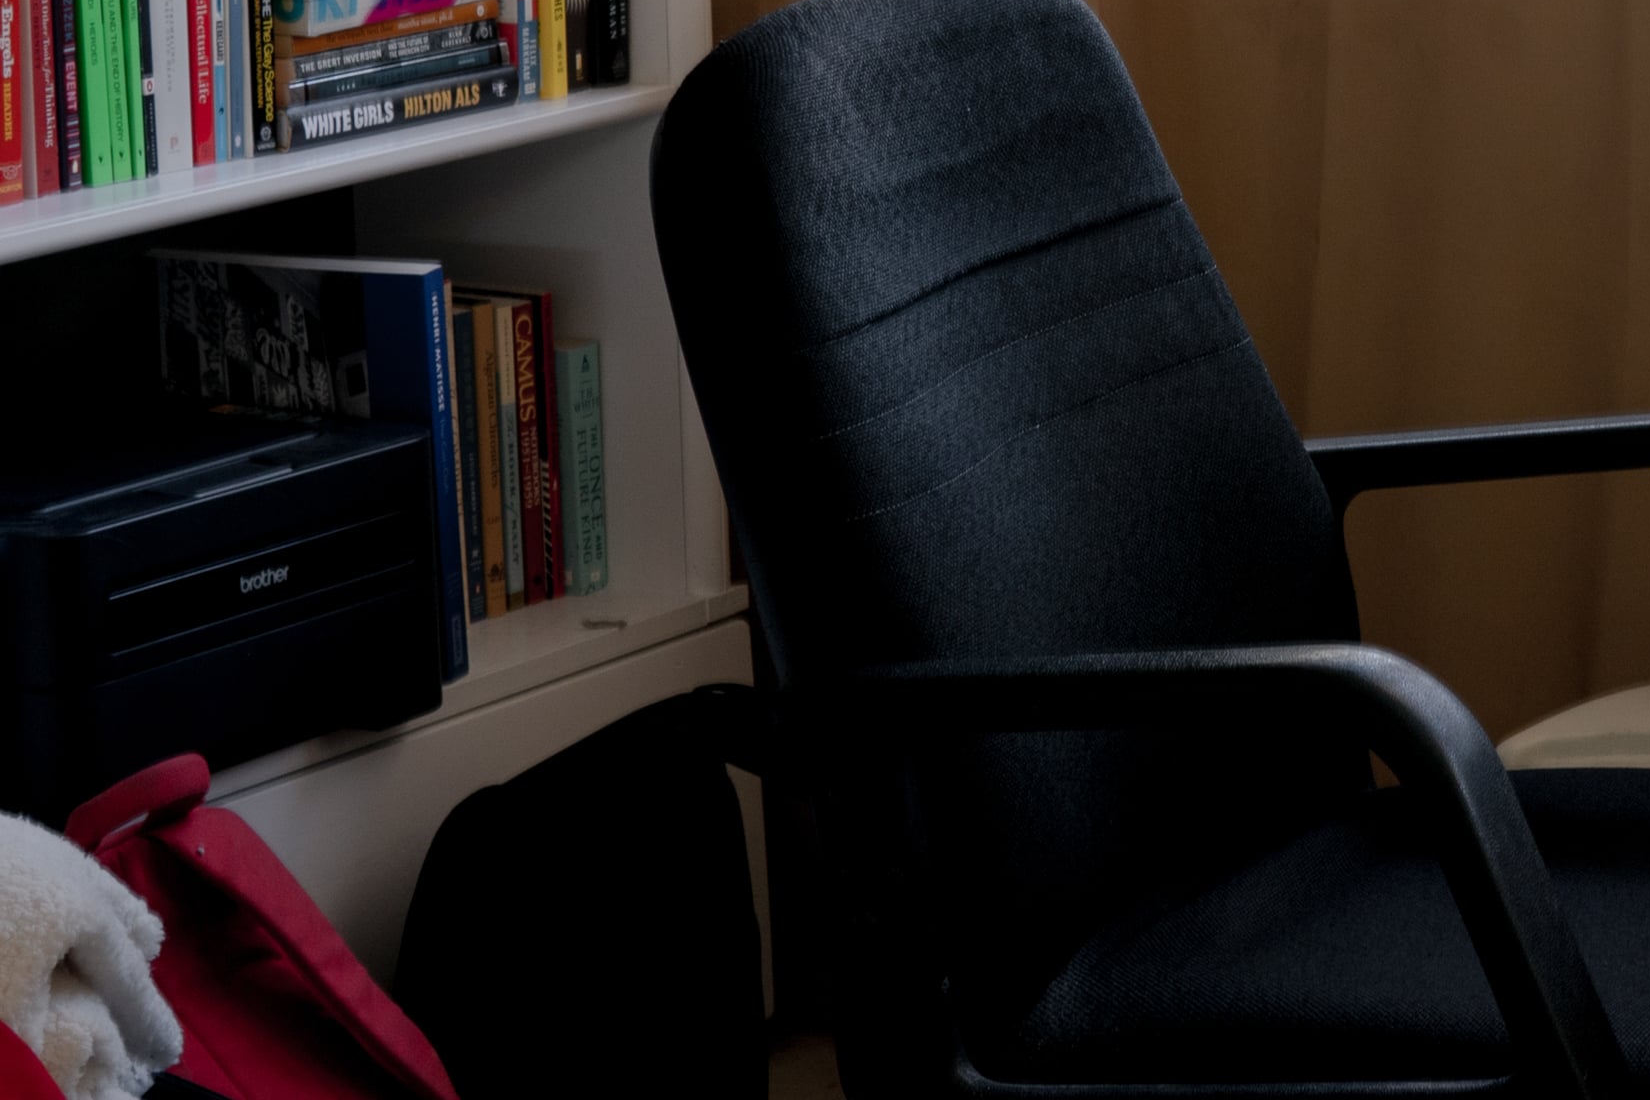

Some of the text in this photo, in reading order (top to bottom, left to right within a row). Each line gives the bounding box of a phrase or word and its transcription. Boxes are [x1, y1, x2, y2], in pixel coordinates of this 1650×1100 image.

[42, 6, 50, 37] Other
[108, 10, 116, 32] AND
[262, 17, 274, 42] The
[90, 22, 98, 65] HEROES
[110, 35, 118, 54] THE
[255, 31, 263, 61] WALTER
[261, 43, 275, 69] Gay
[300, 49, 382, 74] THE GREAT INVERSION
[522, 27, 532, 81] MARKHAM
[529, 39, 537, 68] FELIX
[41, 67, 52, 83] for
[65, 61, 78, 110] EVENT
[112, 57, 120, 79] END
[113, 81, 120, 95] OF
[196, 69, 211, 105] Life
[3, 81, 14, 142] READER
[44, 83, 56, 149] Thinking
[264, 70, 276, 123] Science
[302, 83, 481, 140] WHITE GIRLS HILTON ALS
[114, 97, 124, 142] HISTORY
[431, 292, 446, 413] HENRI MATISSE
[515, 314, 537, 422] CAMUS
[485, 349, 500, 489] Algerian Chronicles
[529, 427, 541, 507] NOTEBOOKS
[576, 429, 593, 565] FUTURE KING
[589, 426, 603, 560] THE ONCE AND
[240, 565, 291, 594] brother
